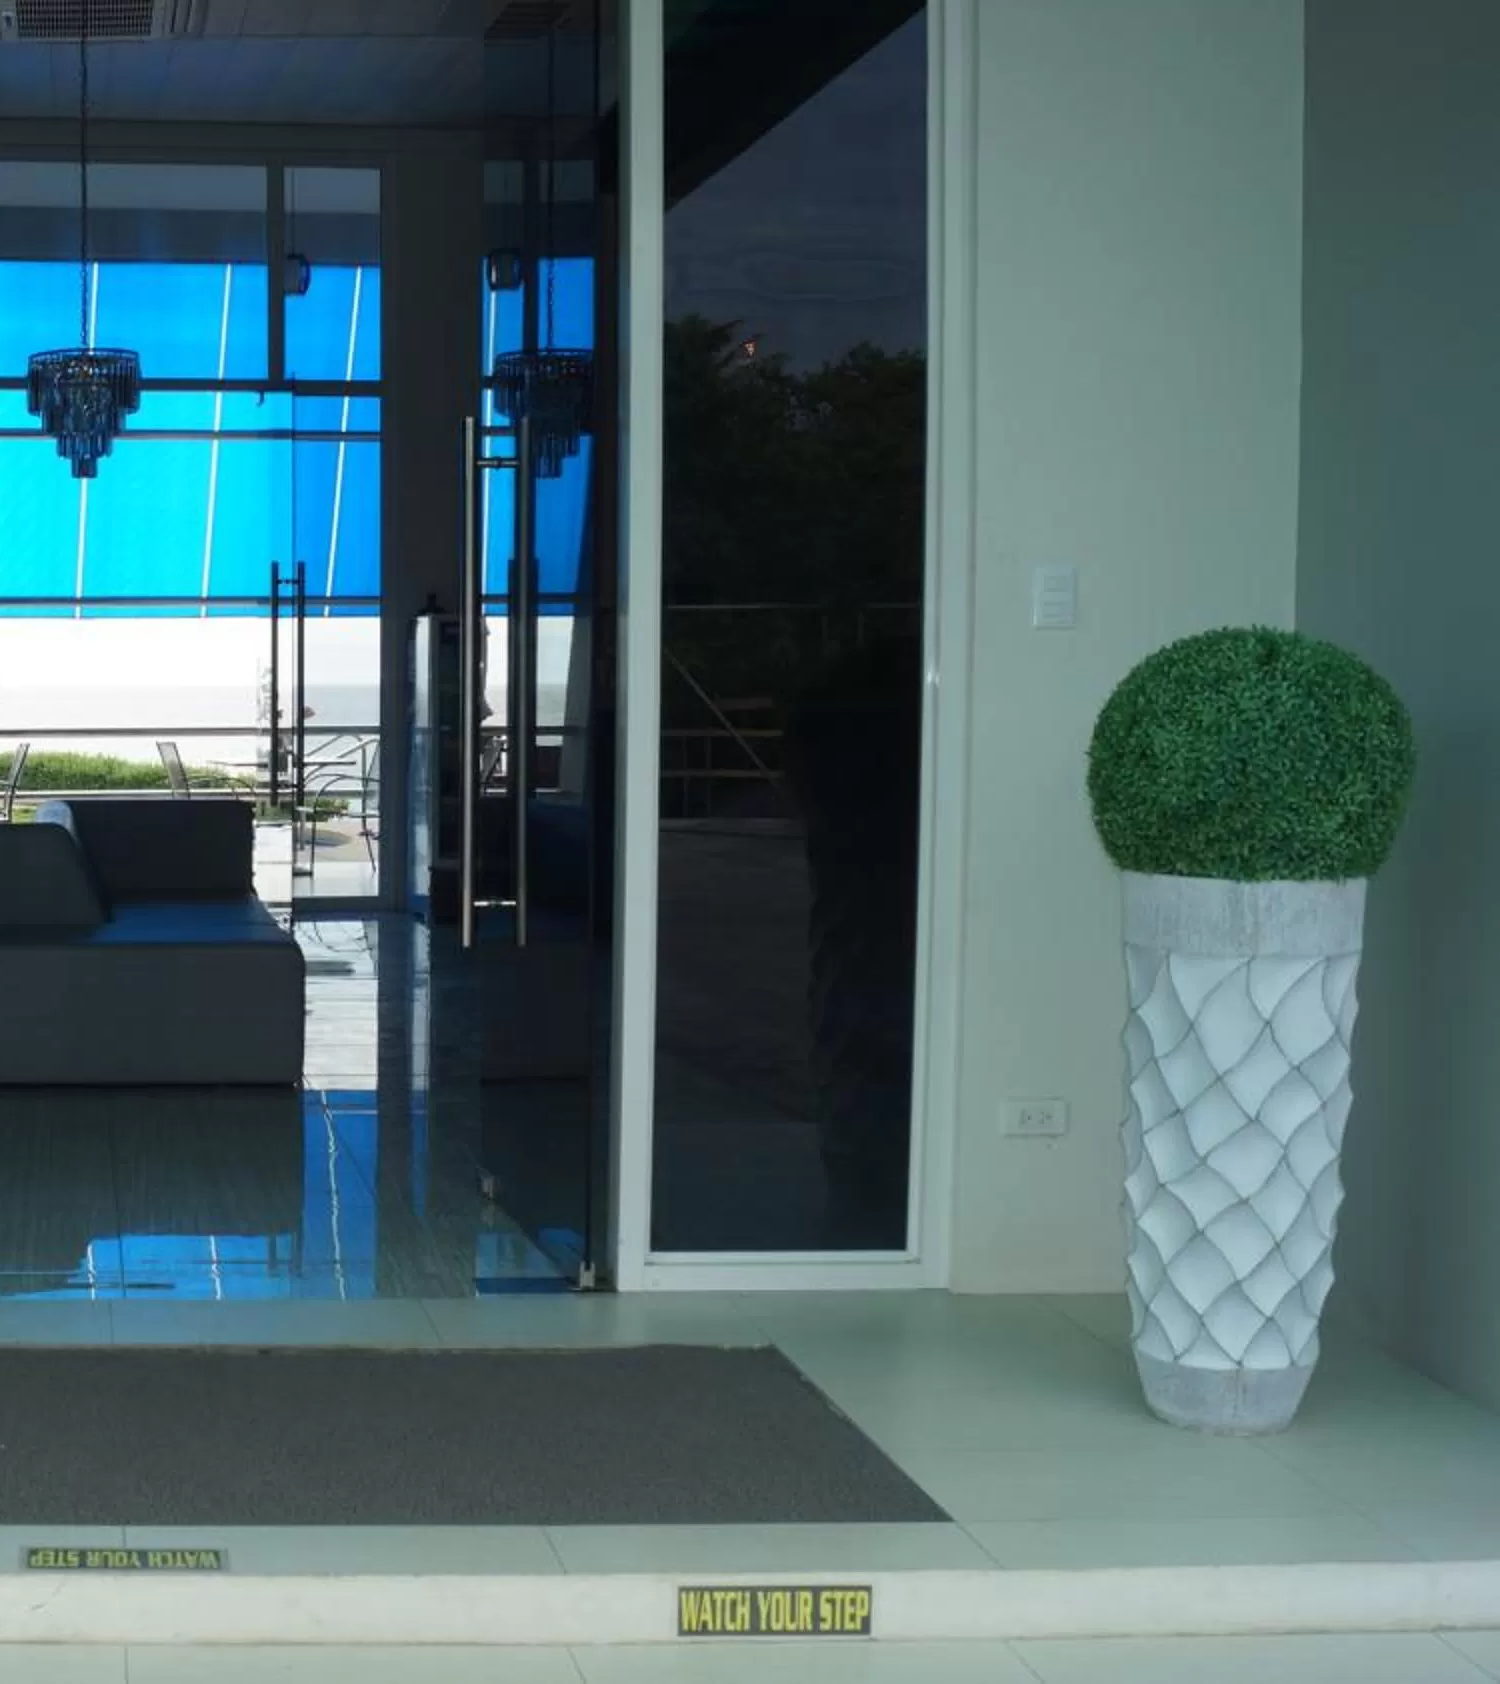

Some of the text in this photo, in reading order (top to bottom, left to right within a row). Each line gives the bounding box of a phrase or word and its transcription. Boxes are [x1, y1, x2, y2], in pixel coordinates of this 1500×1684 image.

[29, 1550, 219, 1568] WATCH YOUR STEP
[680, 1591, 870, 1632] WATCH YOUR STEP
